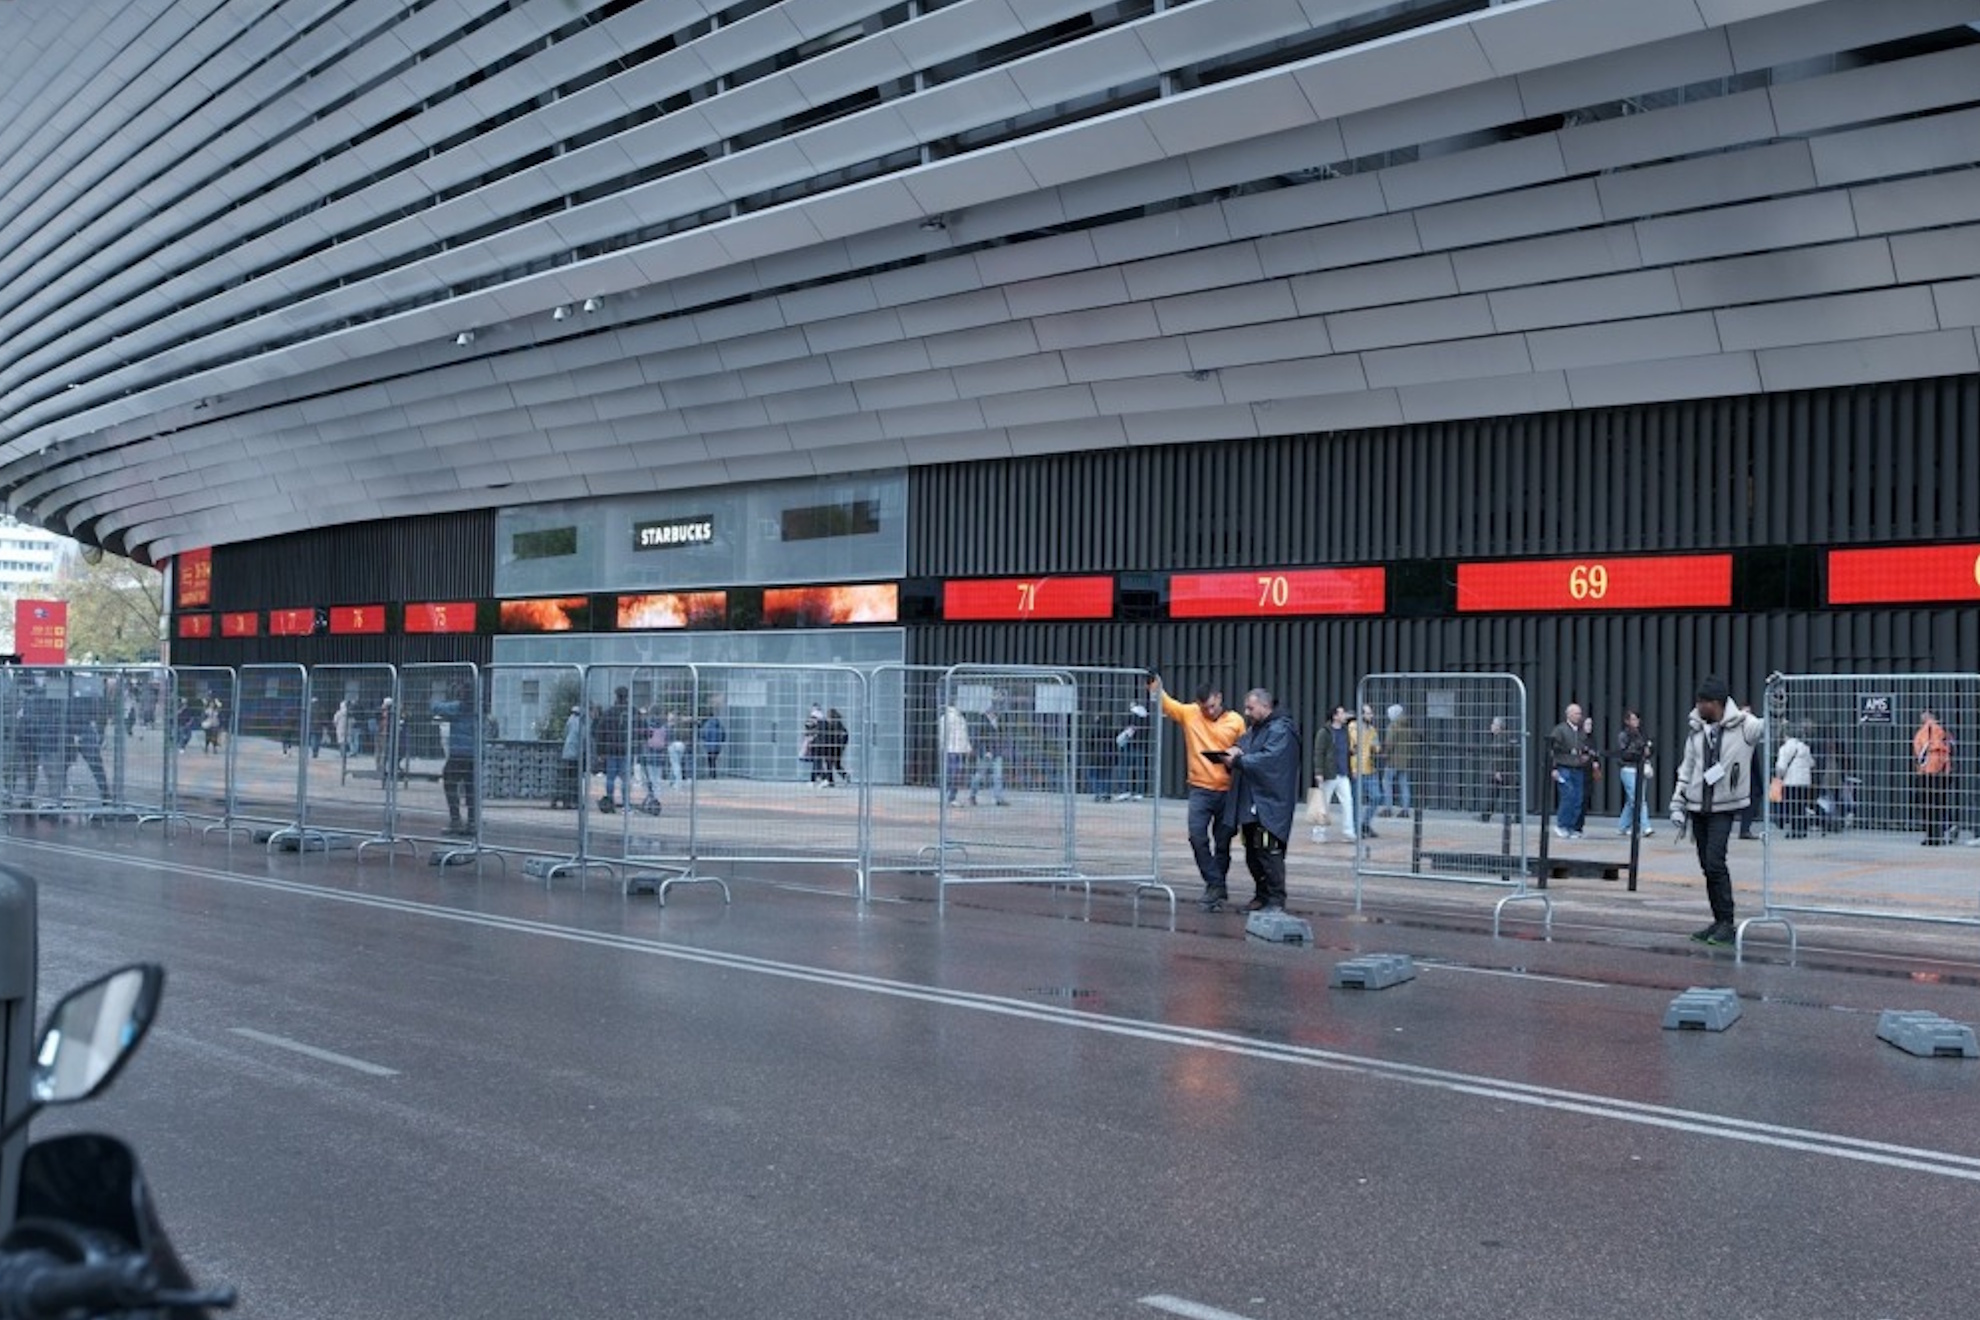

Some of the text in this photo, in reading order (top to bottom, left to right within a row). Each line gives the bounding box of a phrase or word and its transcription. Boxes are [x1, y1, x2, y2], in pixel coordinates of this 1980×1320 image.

[641, 522, 711, 545] STARBUCKS
[1258, 576, 1289, 607] 70
[1570, 564, 1608, 599] 69
[1017, 583, 1035, 611] 71
